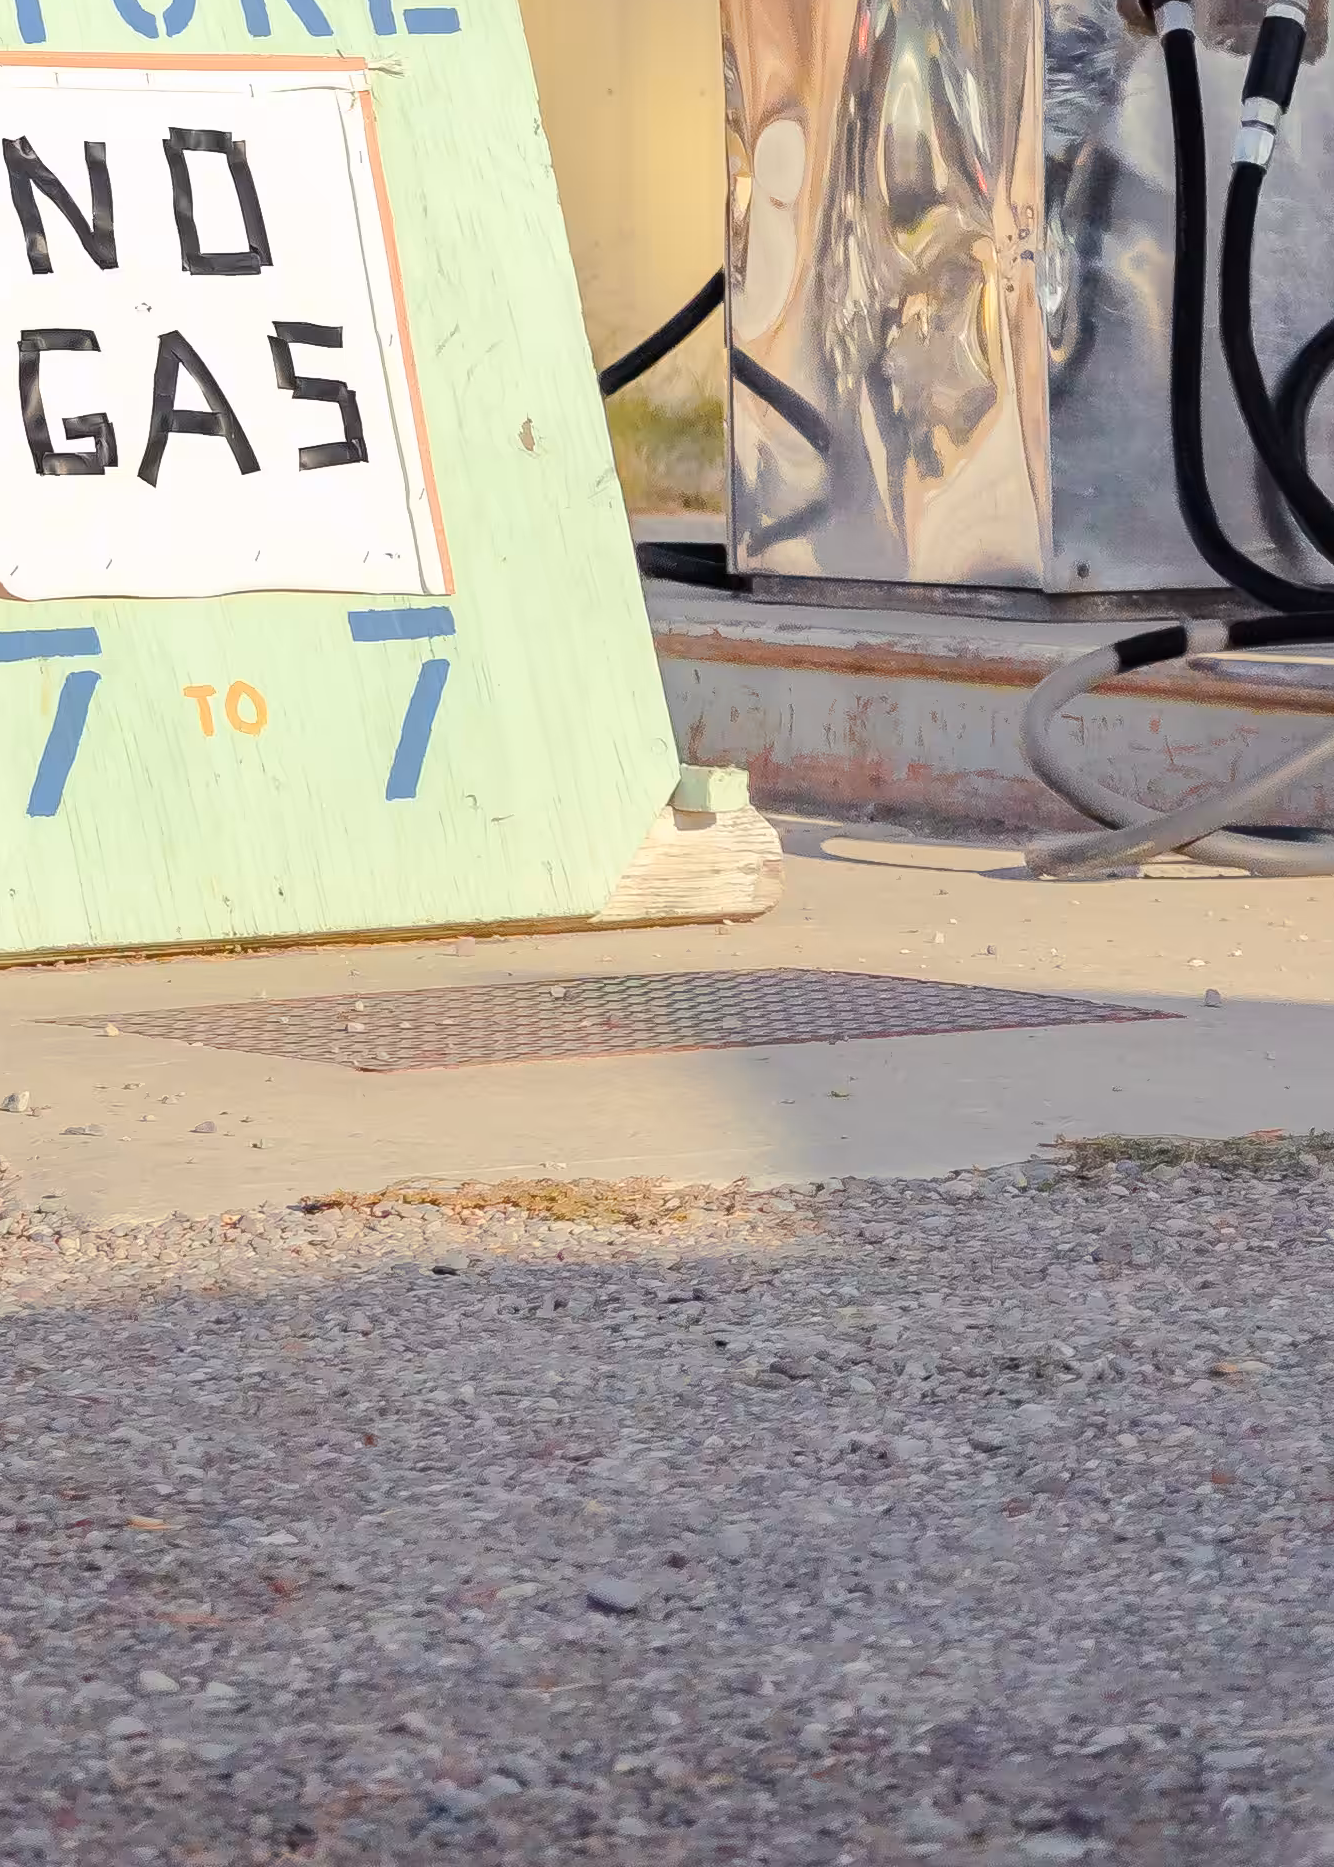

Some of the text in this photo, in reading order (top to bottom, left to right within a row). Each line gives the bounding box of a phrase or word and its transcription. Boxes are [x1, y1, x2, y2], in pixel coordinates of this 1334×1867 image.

[1, 126, 274, 277] NO
[17, 319, 370, 488] GAS
[180, 679, 270, 739] TO
[348, 605, 457, 803] 7
